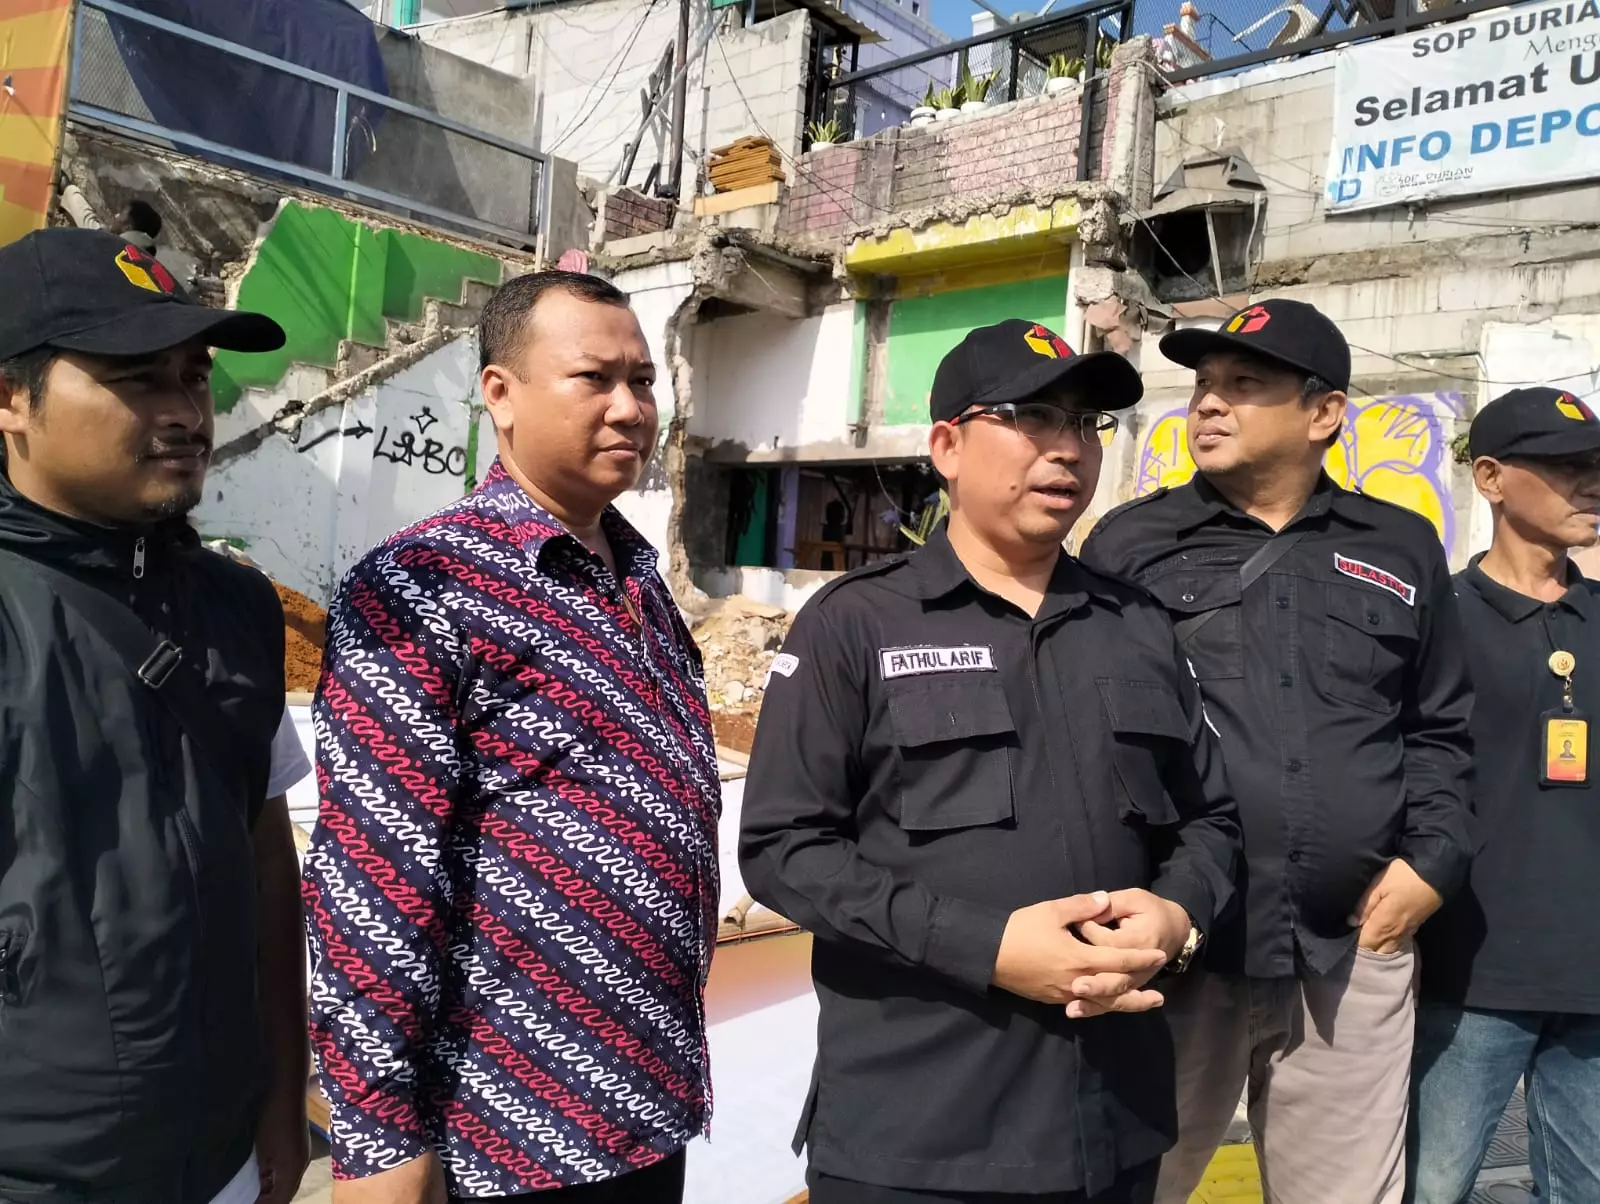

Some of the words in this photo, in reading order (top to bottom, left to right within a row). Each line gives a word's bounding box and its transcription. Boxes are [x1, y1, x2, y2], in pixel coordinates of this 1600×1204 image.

[1412, 27, 1476, 58] SOP
[1489, 0, 1600, 42] DURIA
[1354, 62, 1549, 127] Selamat
[1470, 102, 1600, 155] DEPO
[890, 651, 948, 673] FATHUL
[950, 650, 984, 667] ARIF
